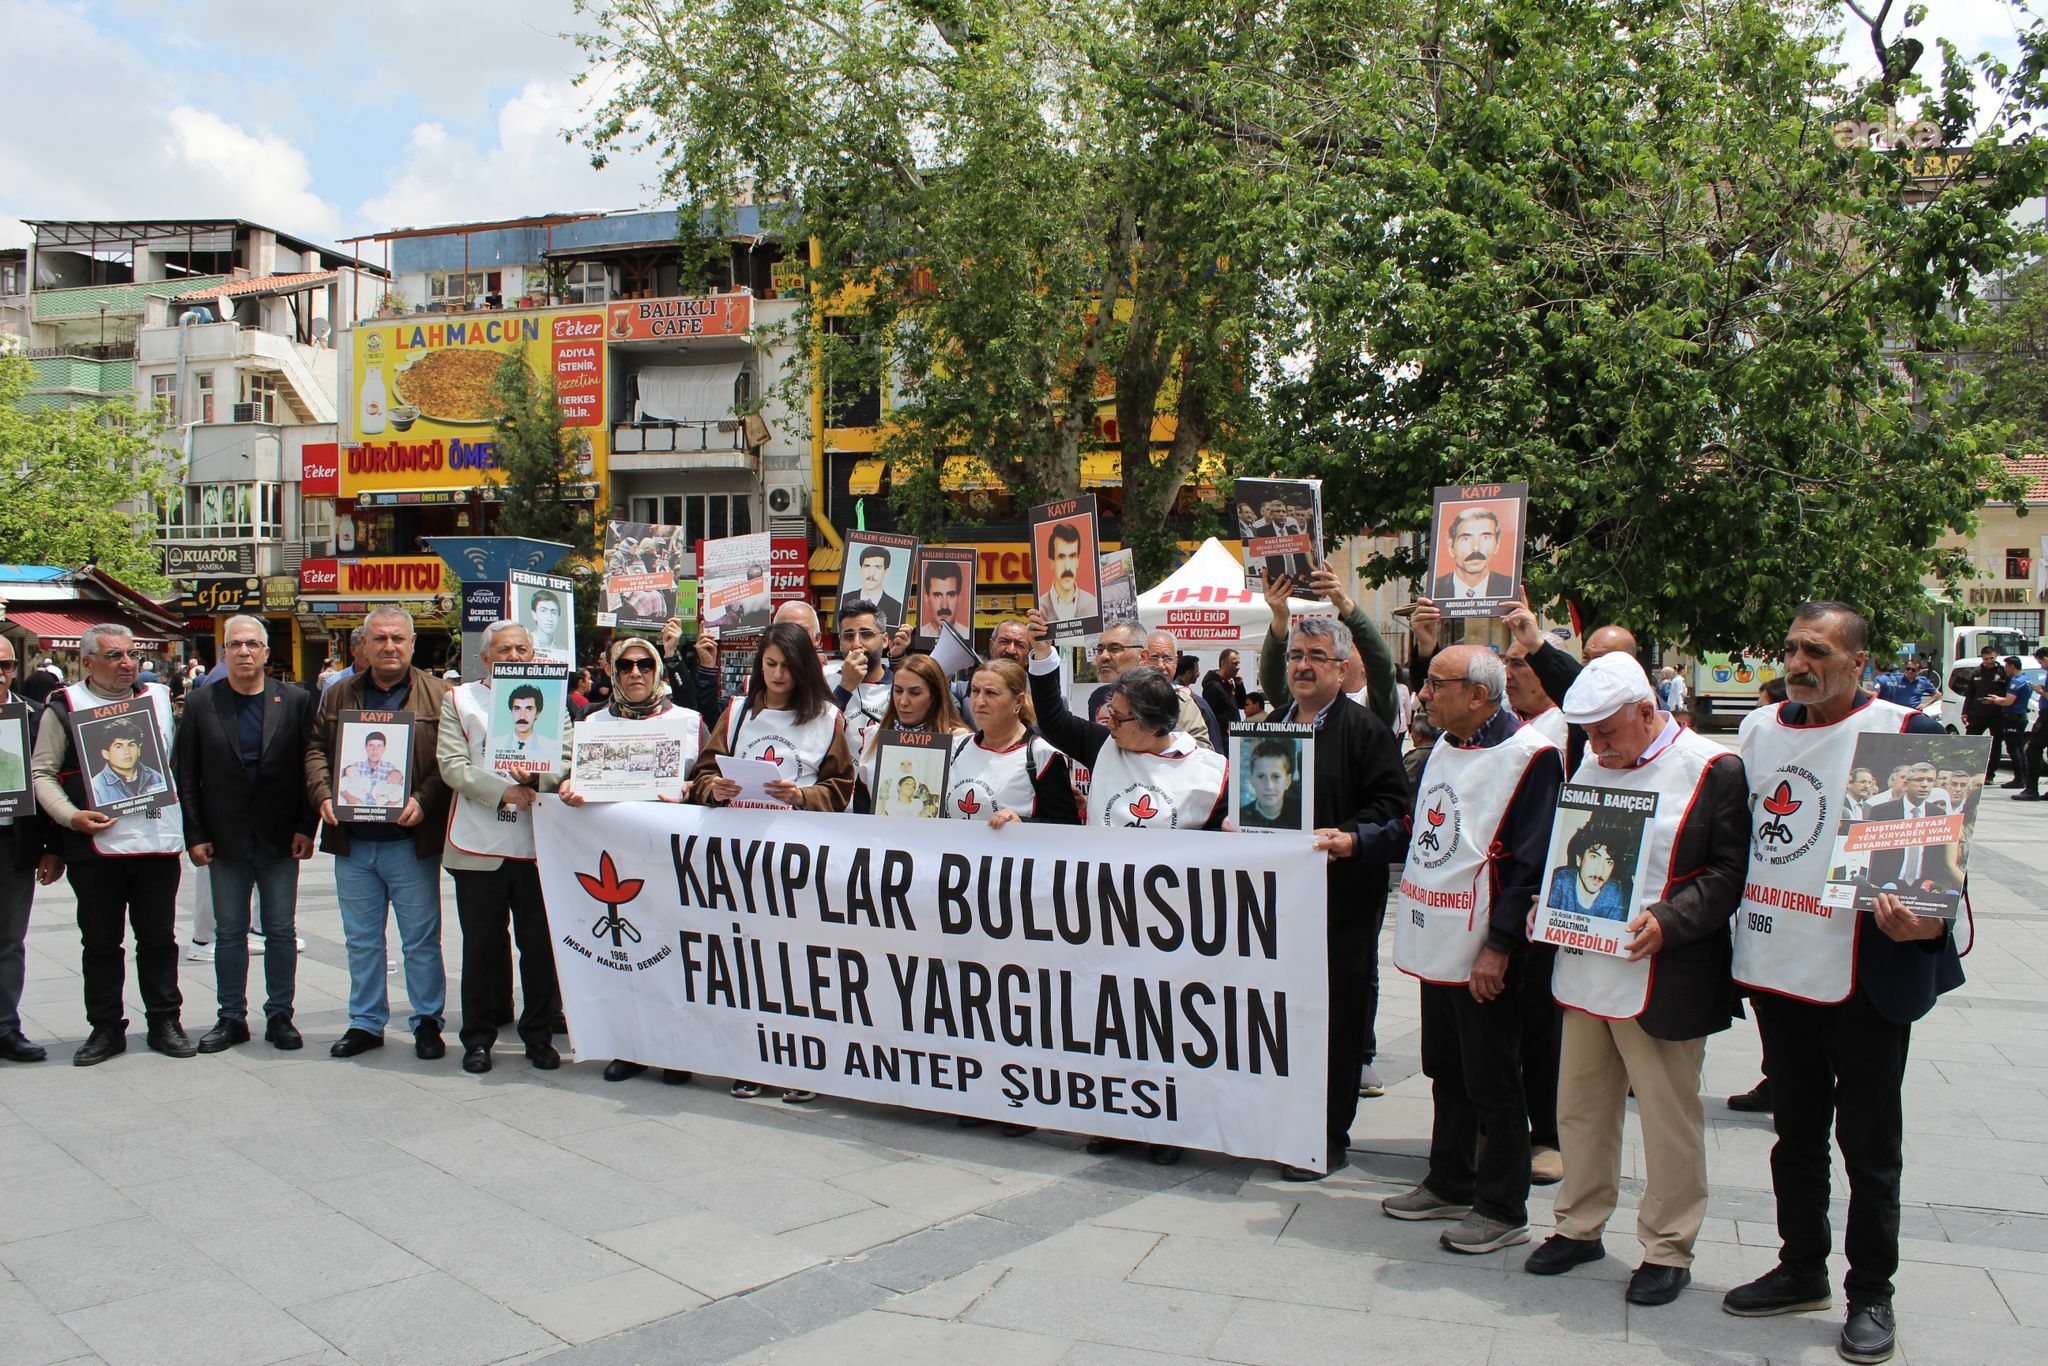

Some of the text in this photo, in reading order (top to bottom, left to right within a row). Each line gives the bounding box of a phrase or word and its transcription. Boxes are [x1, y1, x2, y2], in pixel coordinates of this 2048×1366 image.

[638, 299, 717, 319] BALIKLI
[396, 318, 539, 350] LAHMACUN
[651, 318, 703, 336] CAFE
[559, 347, 596, 358] ADIYLA
[557, 357, 597, 373] İSTENİR,
[557, 373, 601, 390] ezzetini
[348, 438, 443, 474] DÜRÜMCÜ
[1461, 485, 1501, 499] KAYIP
[1047, 500, 1077, 517] KAYIP
[850, 532, 913, 546] FAİLLERİ GİZLENEN
[183, 547, 238, 562] KUAFÖR
[922, 551, 973, 560] FAİLLERİ GİZLENEN
[348, 563, 440, 591] NOHUTCU
[513, 571, 571, 591] FERHAT TEPE
[1970, 587, 2032, 604] DİYANET
[1170, 611, 1227, 624] GÜÇLÜ EKİP
[1190, 628, 1238, 639] KURTARIR
[134, 640, 159, 650] CAĞI
[494, 665, 567, 677] HASAN GÜLÜNAY
[93, 703, 130, 719] KAYIP
[360, 712, 393, 722] KAYIP
[1230, 721, 1313, 732] DAVUT ALTUNKAYNAK
[900, 732, 932, 745] KAYIP
[494, 760, 550, 772] KAYBEDİLDİ
[1798, 768, 1824, 791] DERNEĞİ
[1561, 786, 1655, 813] İSMAİL BAHÇECİ
[1819, 795, 1827, 820] HUMAN
[145, 808, 162, 819] 1986
[497, 810, 517, 823] 1986
[1808, 821, 1824, 845] RIGHTS
[1928, 826, 1951, 834] WAN
[1763, 844, 1777, 852] 1986
[1853, 834, 1953, 850] DIYARIN ZELAL BIKIN
[1770, 843, 1810, 865] ASSOCIATION
[671, 833, 1277, 960] KAYIPLAR BULUNSUN
[1428, 891, 1473, 910] DERNEĞİ
[1744, 882, 1781, 907] AKLARI
[1549, 918, 1588, 932] GÖZALTINDA
[1748, 912, 1772, 934] 1986
[1545, 927, 1619, 954] KAYBEDİLDİ
[562, 934, 672, 973] İNSAN HAKLARI DERNEĞİ
[610, 950, 628, 962] 1986
[679, 922, 1289, 1077] FAİLLER YARGILANSIN
[757, 1023, 1178, 1121] İHD ANTEP ŞUBESİ
